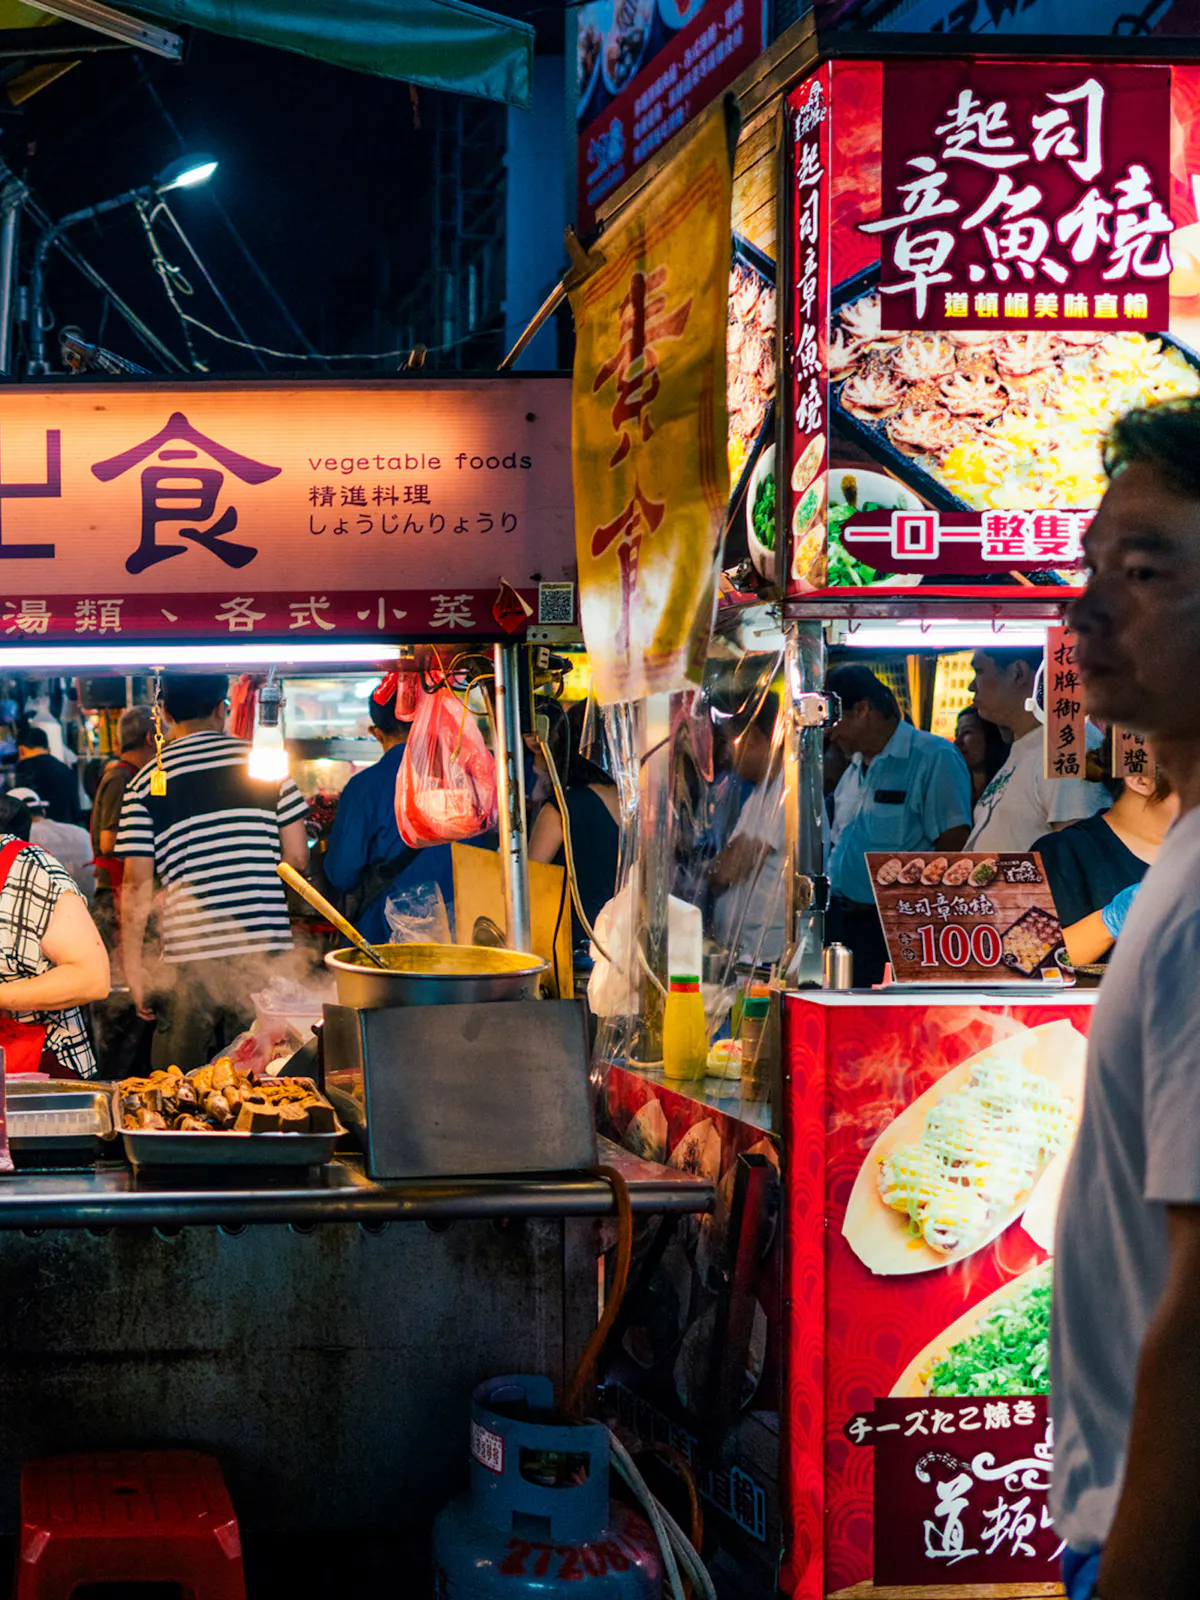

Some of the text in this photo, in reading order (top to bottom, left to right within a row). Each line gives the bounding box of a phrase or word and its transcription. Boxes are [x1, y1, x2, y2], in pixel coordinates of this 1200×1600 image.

[933, 78, 1105, 183] 起司
[857, 156, 1175, 320] 章魚燒
[796, 142, 825, 434] 起司章魚燒
[308, 452, 533, 475] vegetable foods
[308, 484, 431, 507] 精進料理
[308, 511, 519, 536] しょうじんりょうり
[1053, 643, 1080, 775] 招牌御多福
[896, 892, 995, 922] 起司章魚燒
[917, 924, 1002, 967] 100
[849, 1400, 1036, 1444] チーズたこ焼き
[922, 1473, 1068, 1567] 道頓
